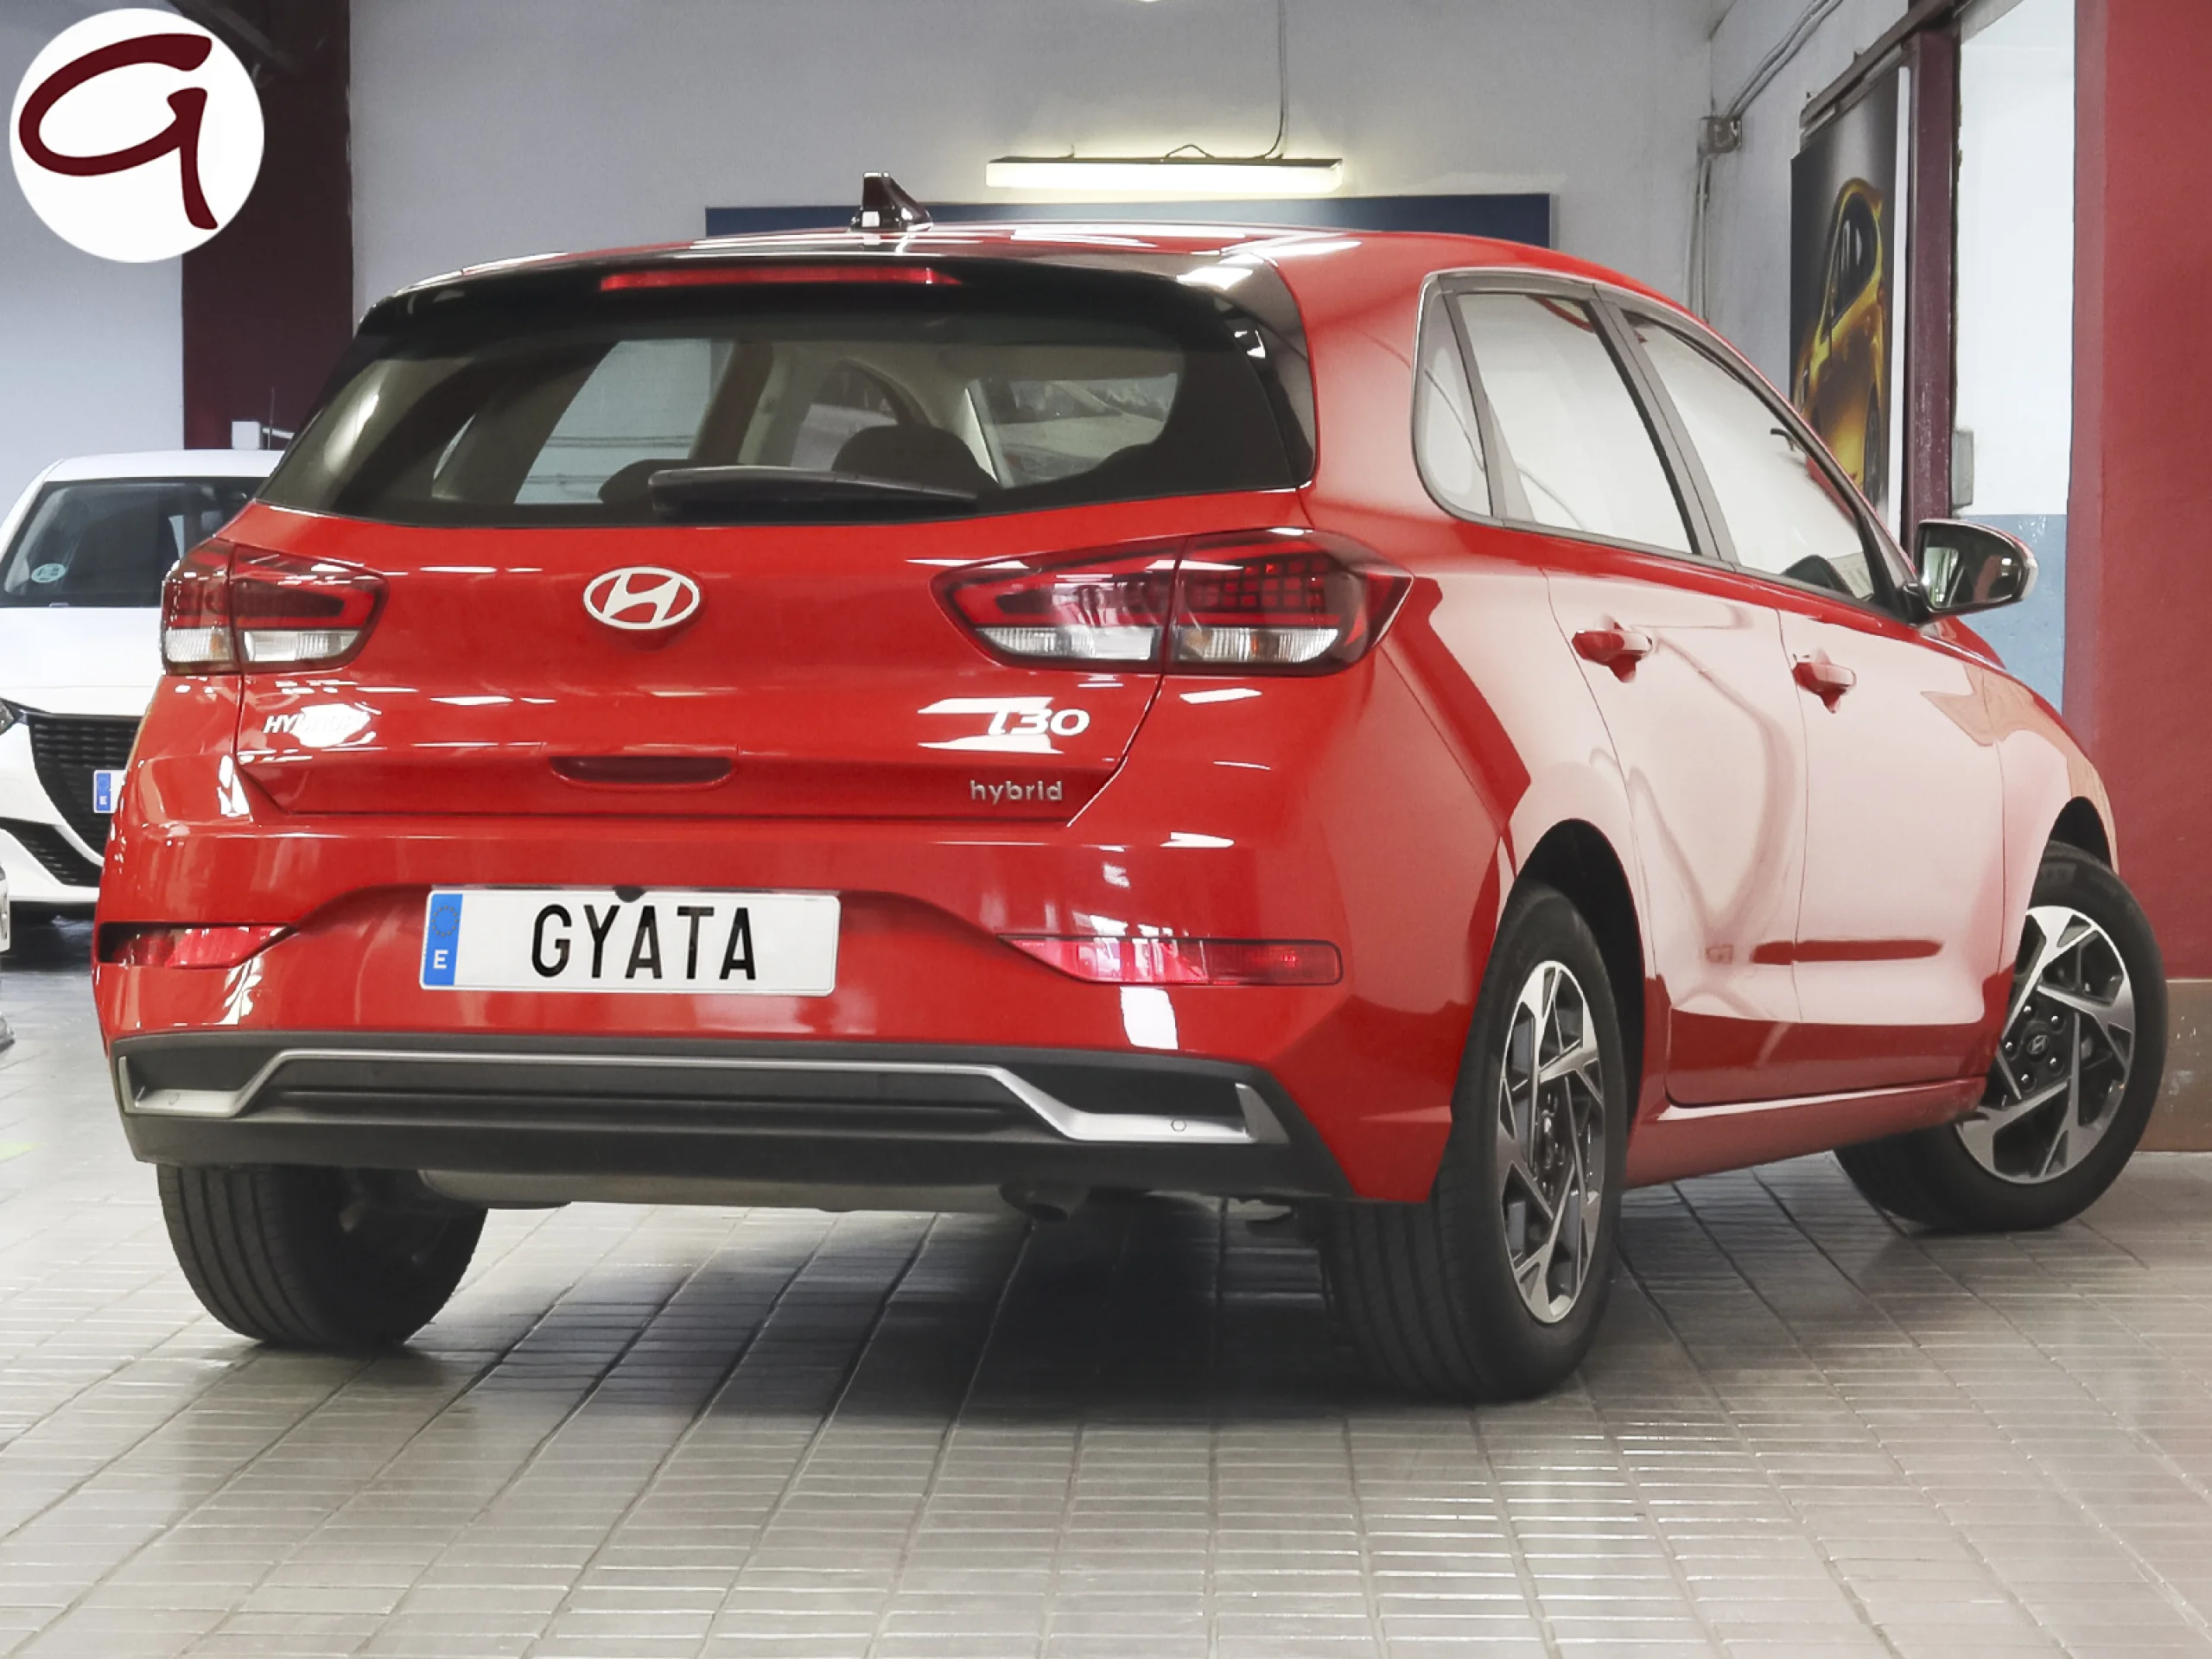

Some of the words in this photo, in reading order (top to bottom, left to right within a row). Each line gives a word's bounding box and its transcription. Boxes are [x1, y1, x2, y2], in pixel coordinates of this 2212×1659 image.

[970, 780, 1063, 804] hybrid
[531, 904, 756, 980] GYATA
[433, 950, 449, 969] E
